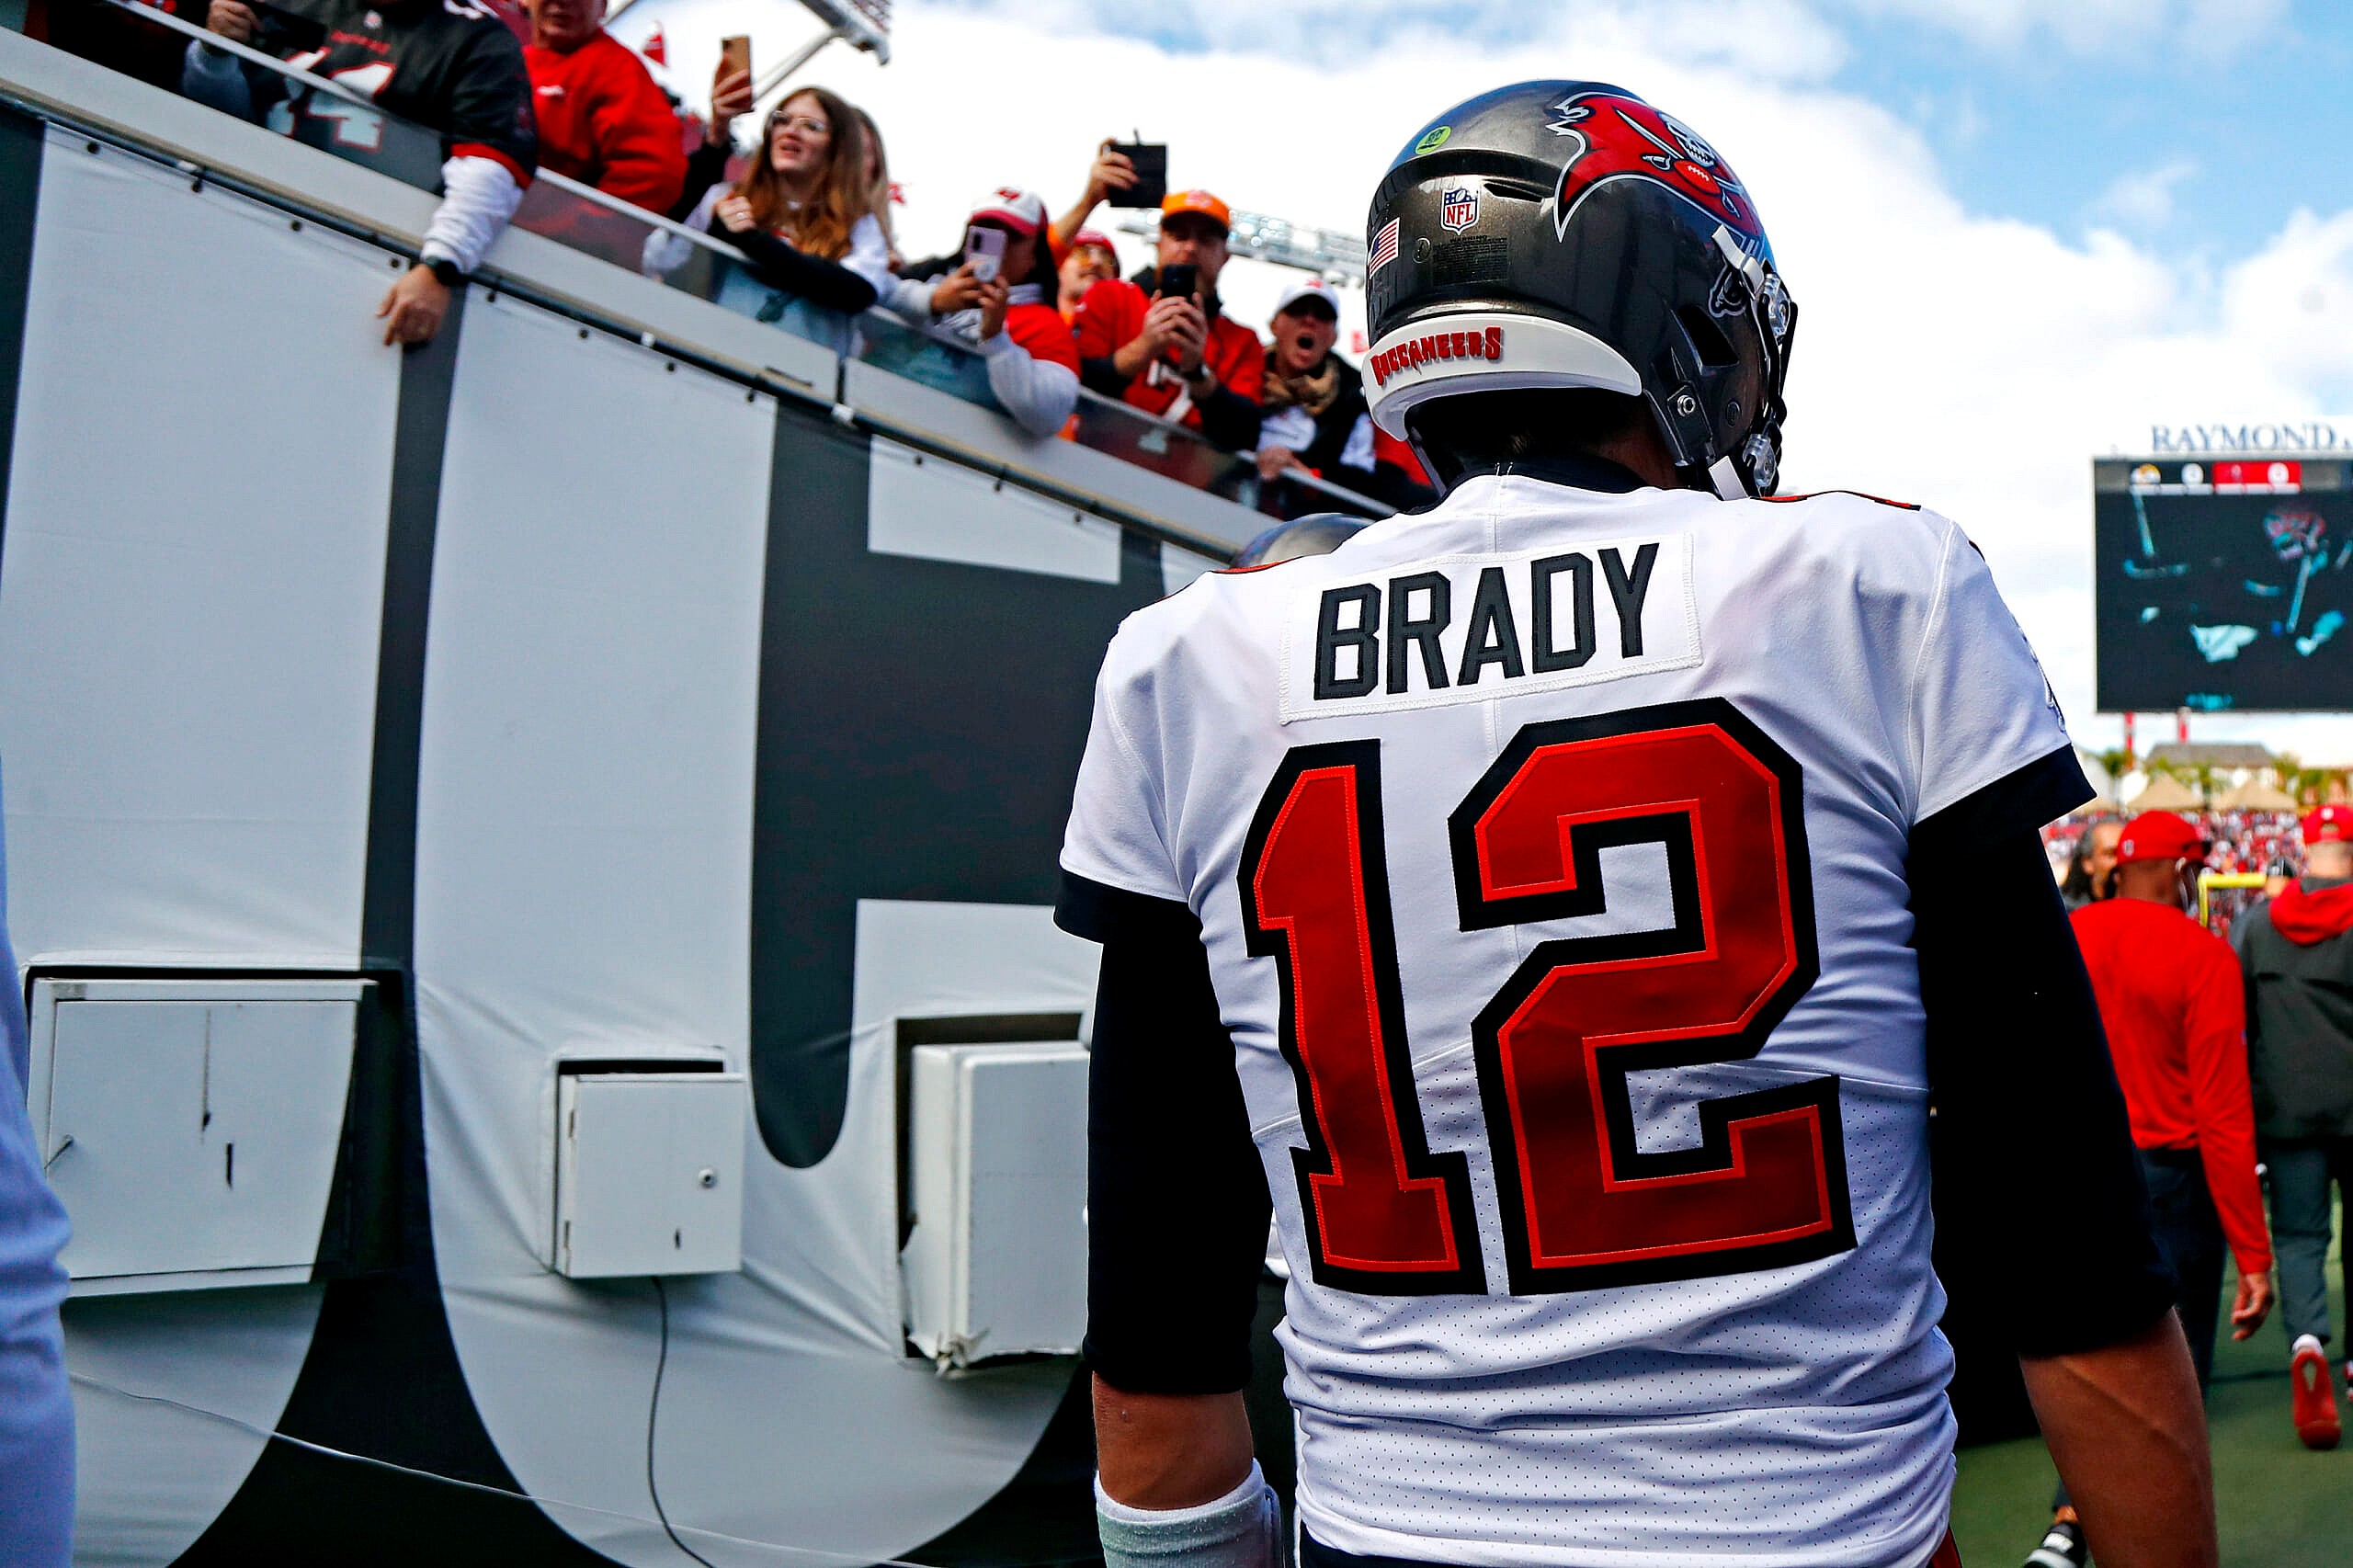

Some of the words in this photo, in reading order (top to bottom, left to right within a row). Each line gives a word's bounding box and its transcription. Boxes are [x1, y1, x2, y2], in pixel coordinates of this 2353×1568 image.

[1446, 203, 1472, 225] NFL
[1370, 327, 1501, 386] BUCCANEERS
[2152, 425, 2336, 451] RAYMOND
[1313, 543, 1660, 699] BRADY
[1235, 697, 1858, 1297] 12
